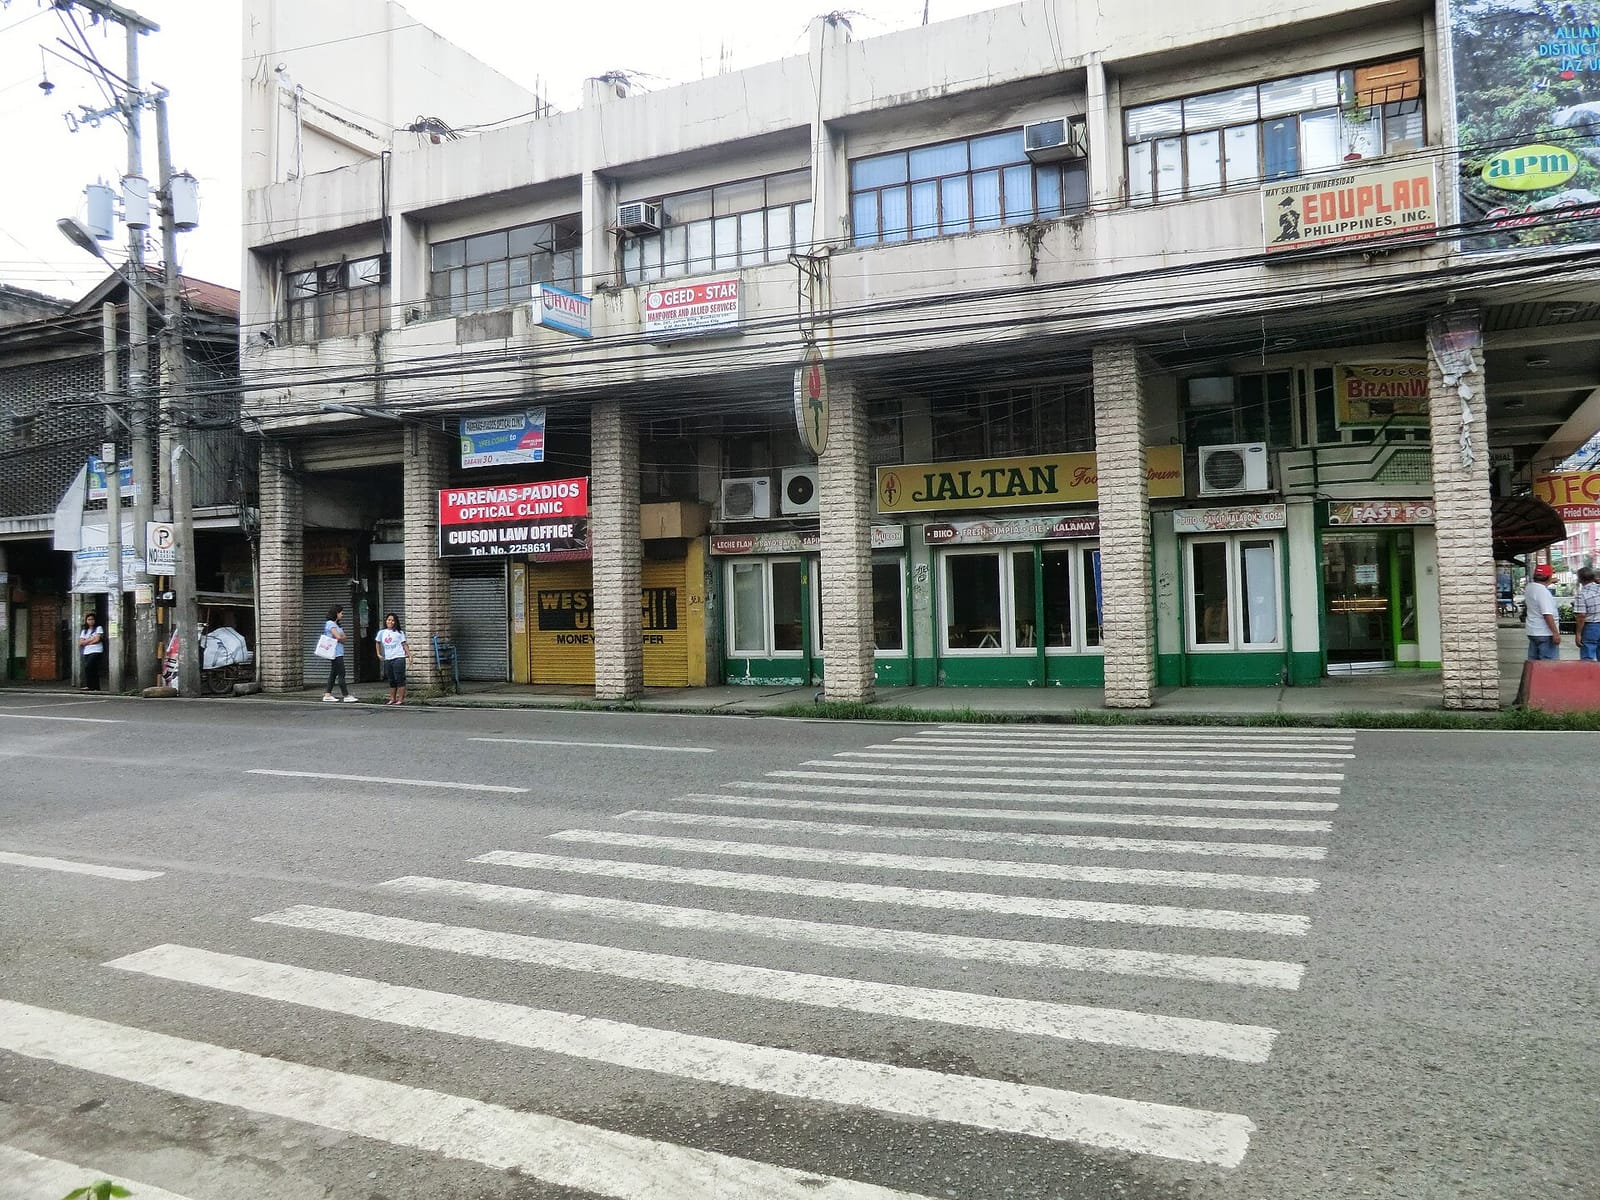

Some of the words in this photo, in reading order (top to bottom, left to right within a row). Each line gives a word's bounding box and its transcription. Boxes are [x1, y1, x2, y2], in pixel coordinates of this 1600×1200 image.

[1559, 57, 1583, 71] JAZ
[1302, 176, 1430, 225] EDUPLAN
[1304, 215, 1397, 238] PHILIPPINES,
[1402, 209, 1431, 223] INC.
[664, 288, 695, 305] GEED
[706, 284, 737, 300] STAR
[554, 293, 588, 317] HYATT
[647, 310, 678, 321] MANPOWER
[678, 308, 690, 318] AND
[690, 305, 709, 316] ALLIED
[710, 301, 737, 313] SERVICES
[911, 463, 1059, 502] JALTAN
[448, 483, 580, 506] PAREÑAS-PADIOS
[460, 507, 514, 520] OPTICAL
[517, 501, 563, 516] CLINIC
[1352, 507, 1399, 519] FAST
[1563, 507, 1582, 517] Fried
[159, 529, 170, 546] P
[449, 529, 497, 544] CUISON
[500, 526, 529, 542] LAW
[530, 524, 574, 540] OFFICE
[933, 529, 953, 538] BIKO
[961, 527, 986, 537] FRESH
[1030, 525, 1043, 533] PIE
[1053, 521, 1096, 532] KALAMAY
[470, 546, 488, 555] Tel.
[490, 545, 508, 554] No.
[717, 541, 735, 549] LECHE
[736, 540, 753, 548] FLAN
[557, 634, 596, 645] MONEY
